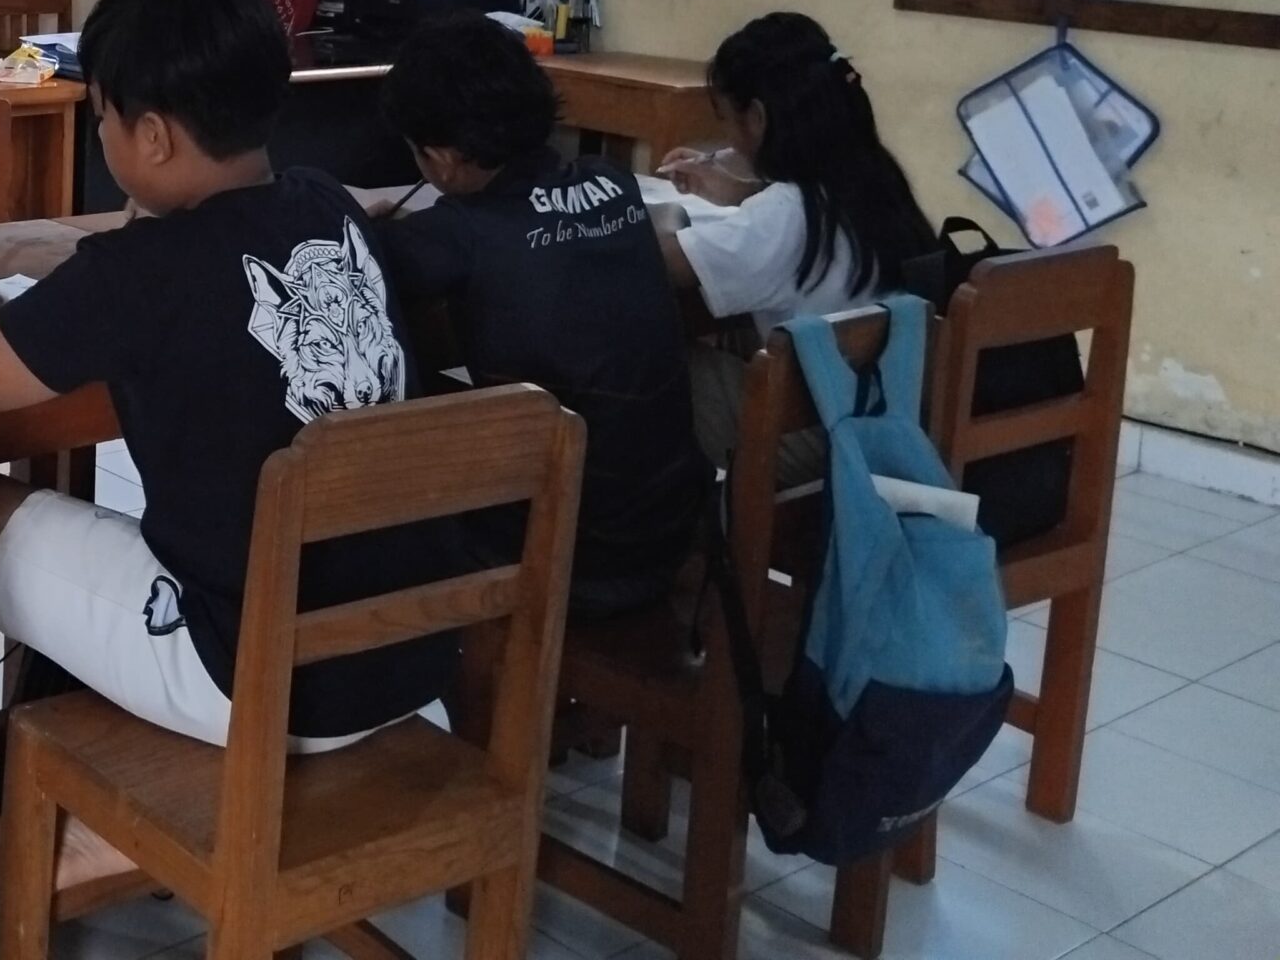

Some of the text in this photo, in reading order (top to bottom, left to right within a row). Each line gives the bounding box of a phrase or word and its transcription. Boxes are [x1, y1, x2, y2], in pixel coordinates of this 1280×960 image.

[526, 227, 551, 249] To
[556, 220, 572, 242] be
[574, 214, 624, 239] Number
